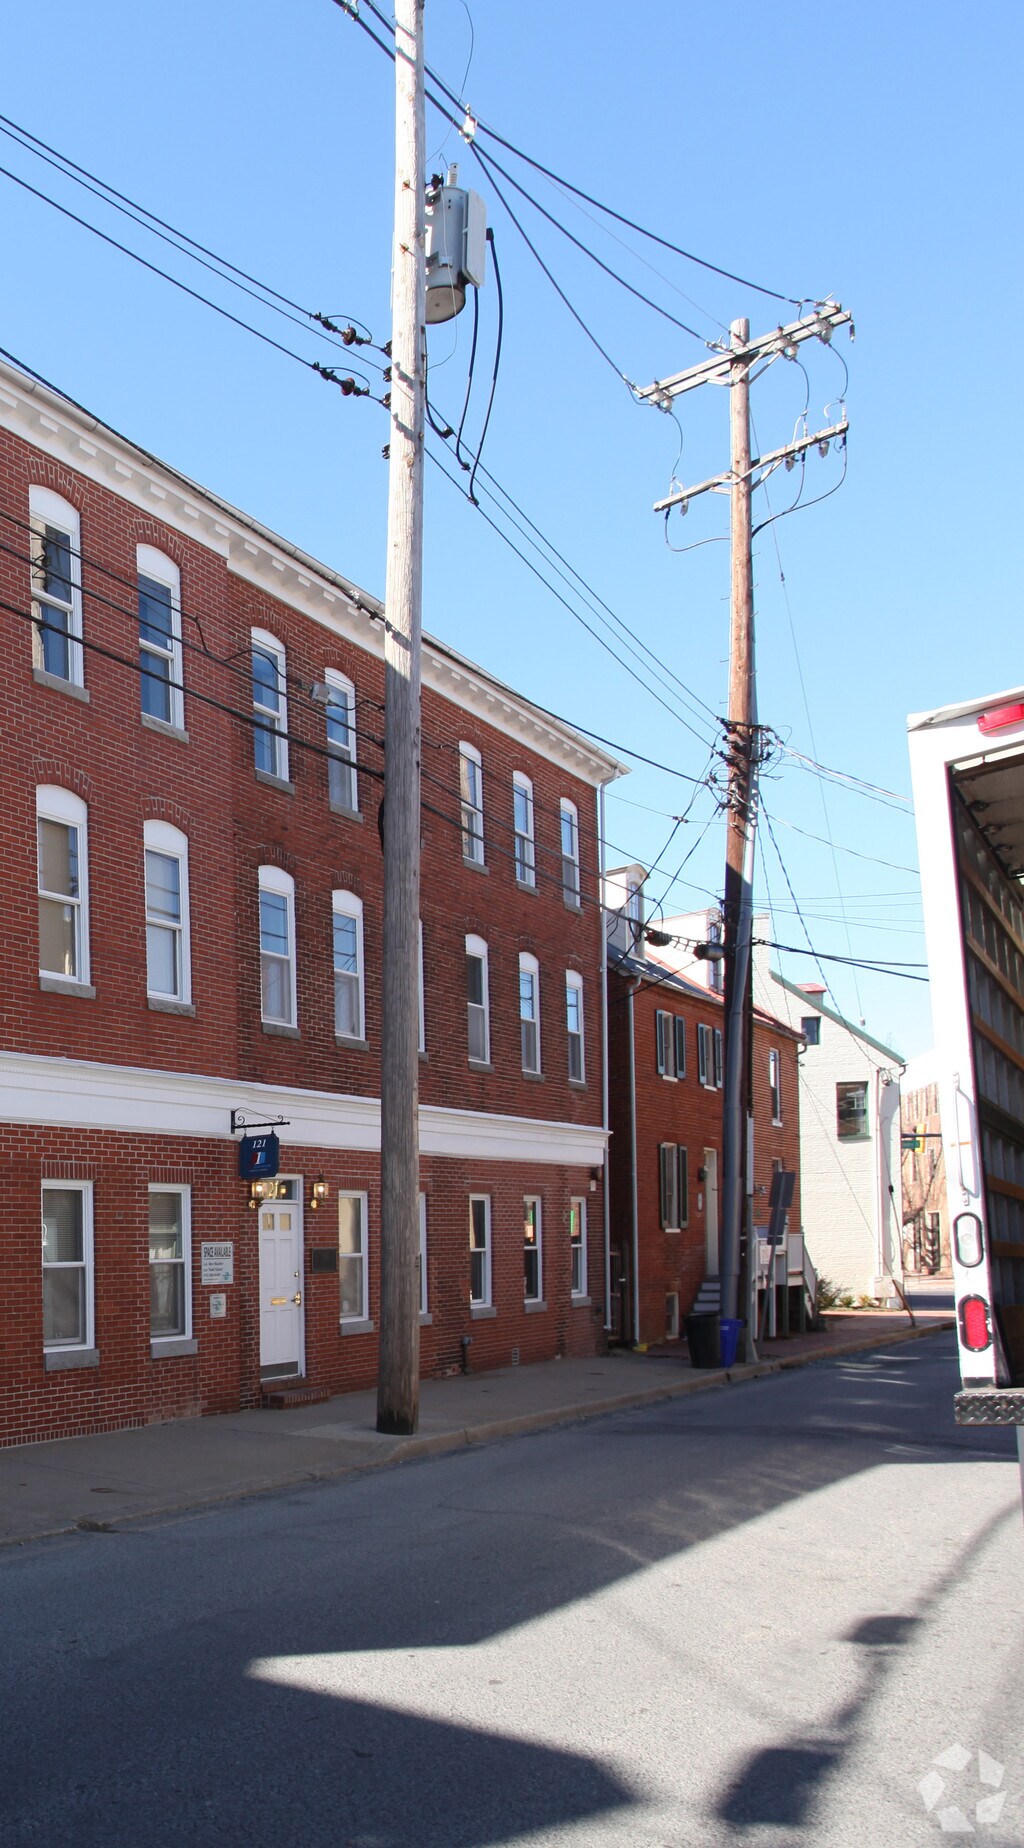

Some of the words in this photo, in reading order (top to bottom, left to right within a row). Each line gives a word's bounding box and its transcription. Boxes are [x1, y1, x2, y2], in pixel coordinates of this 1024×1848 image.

[252, 1139, 266, 1148] 121
[254, 1152, 262, 1165] 1
[203, 1247, 214, 1257] SPACE
[214, 1247, 231, 1257] AVAILABLE
